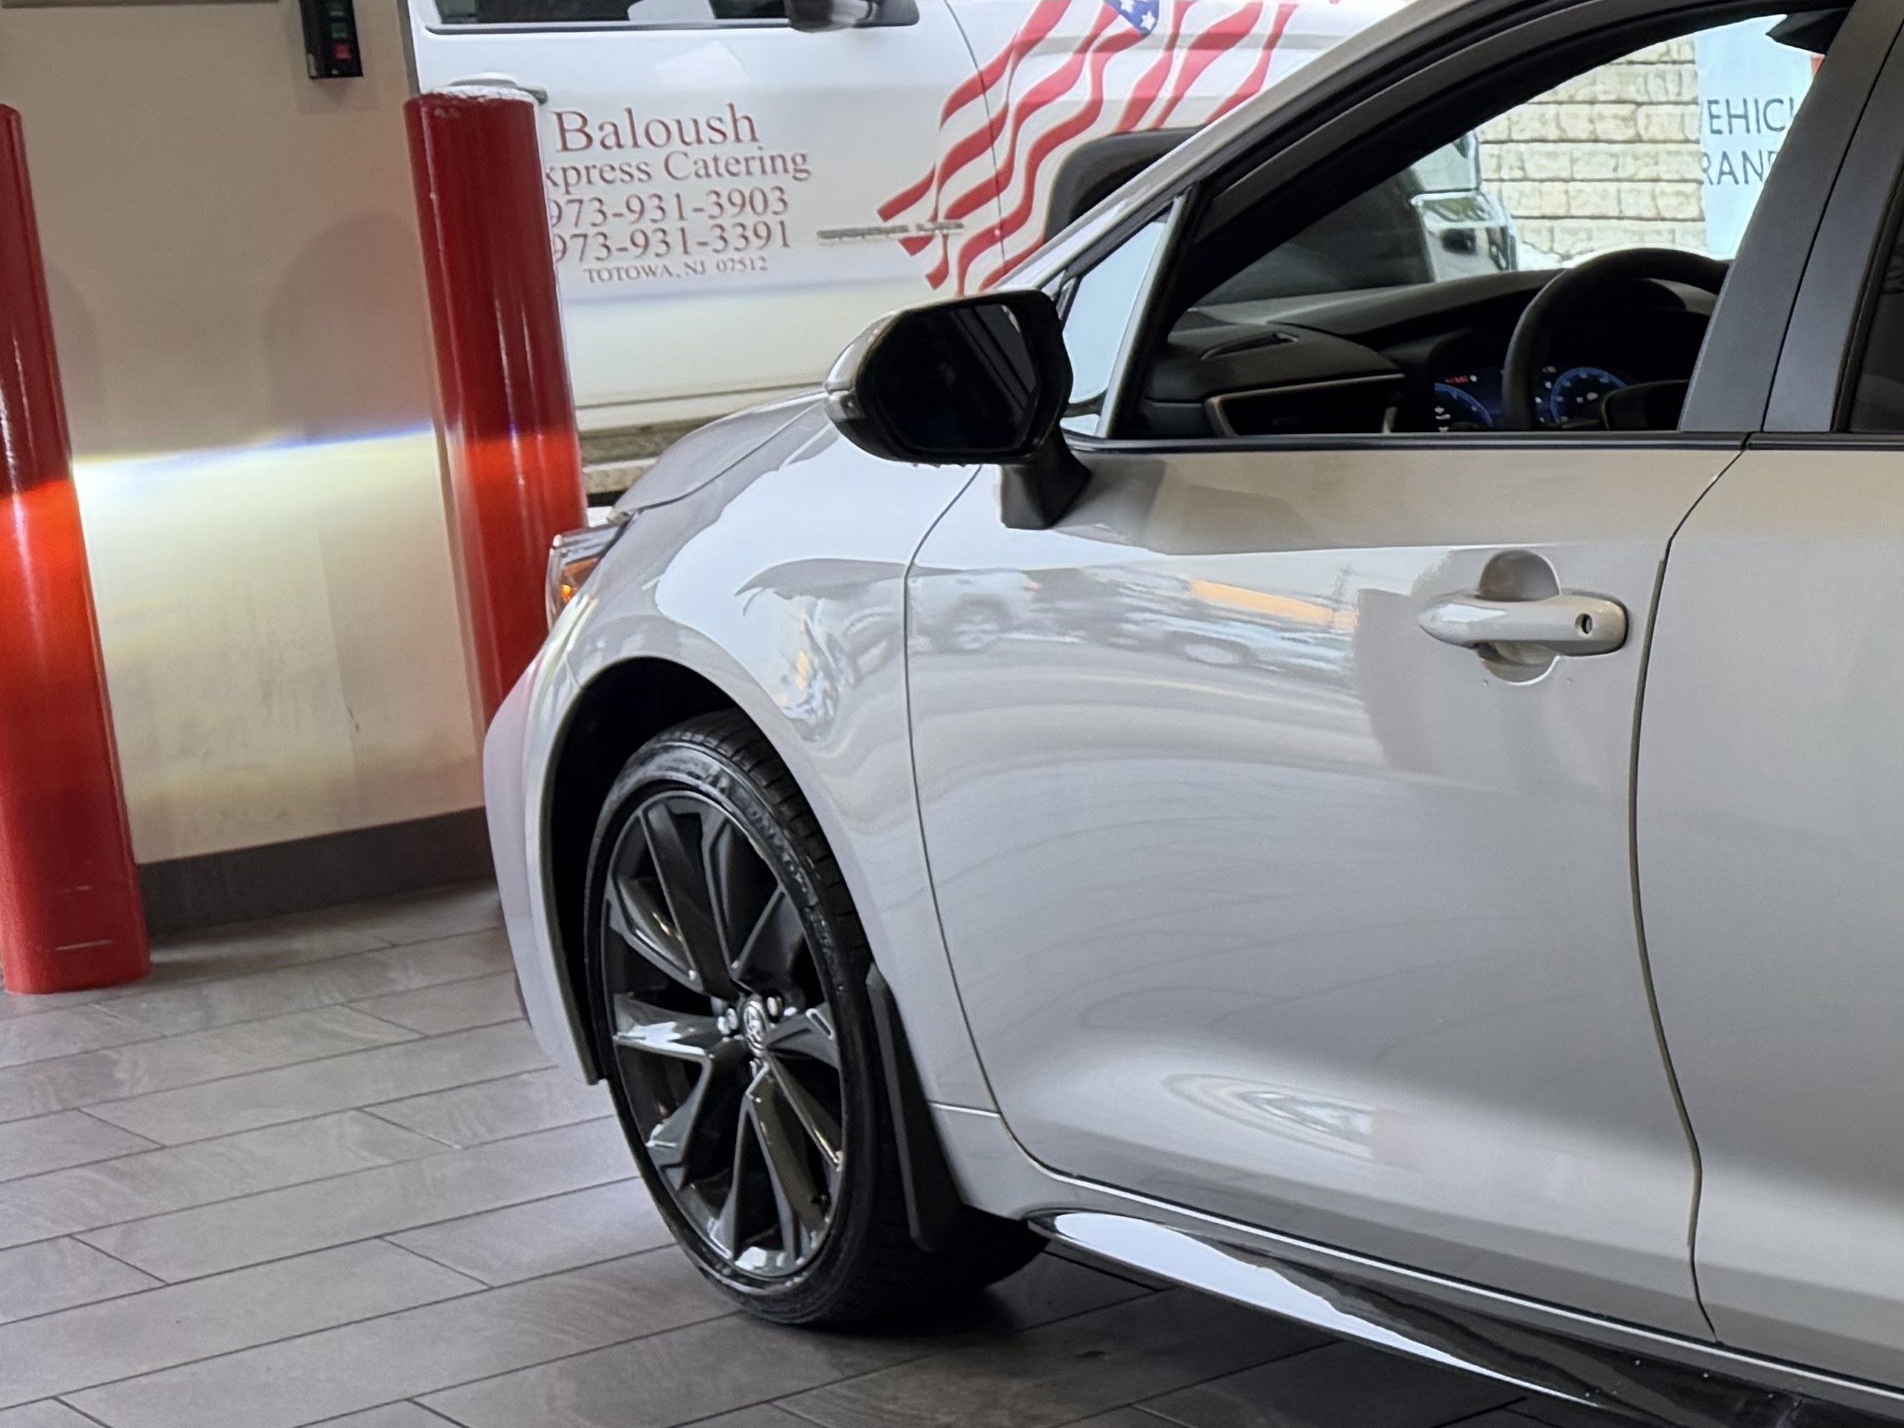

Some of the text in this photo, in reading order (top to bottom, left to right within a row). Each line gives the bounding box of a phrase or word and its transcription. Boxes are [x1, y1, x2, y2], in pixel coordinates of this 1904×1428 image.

[552, 101, 762, 153] Baloush
[1706, 97, 1795, 134] EHIC
[546, 146, 812, 194] xpress Catering
[683, 260, 706, 275] NJ
[716, 256, 769, 273] 07512
